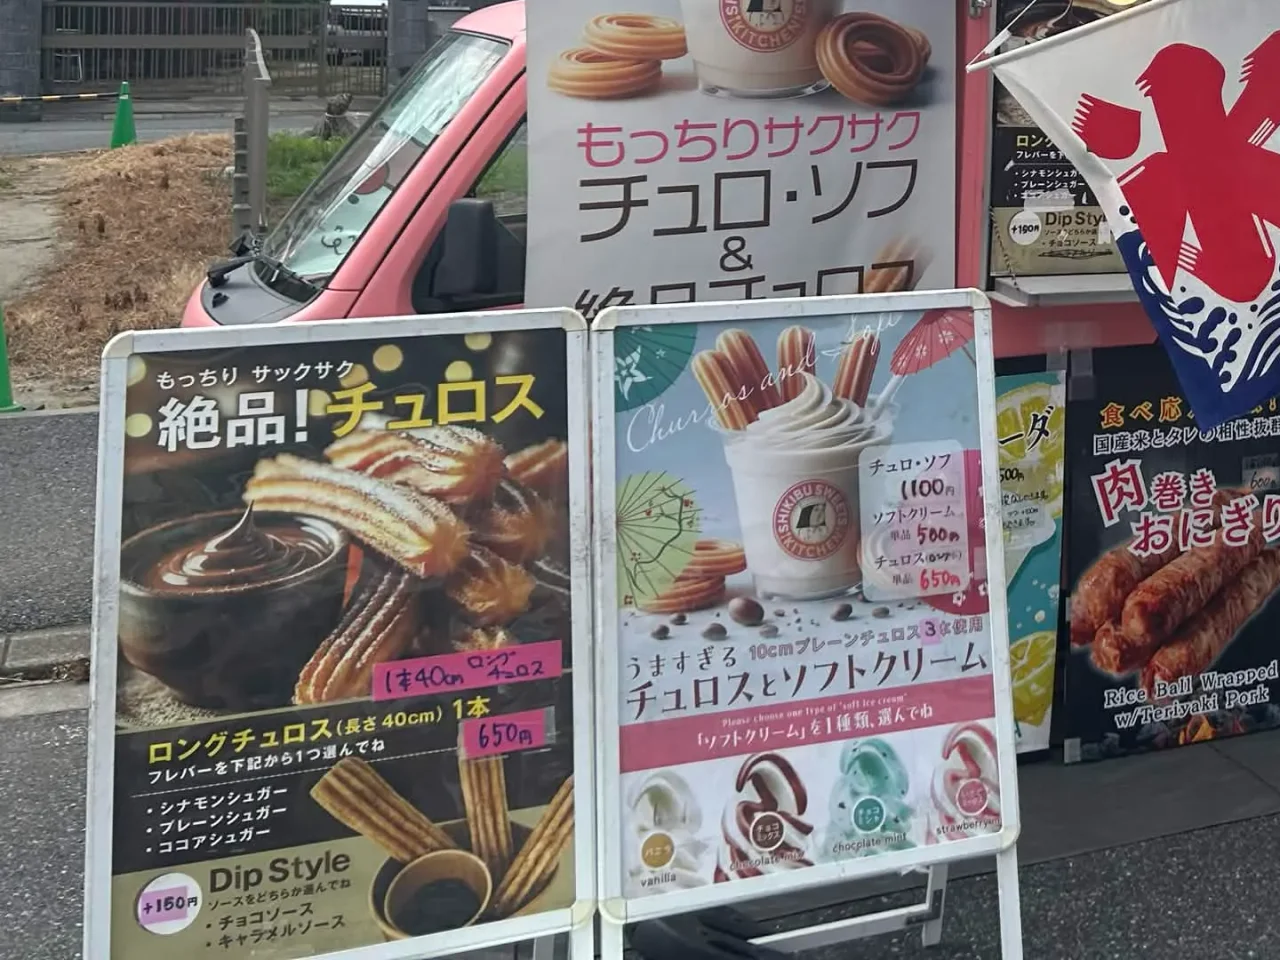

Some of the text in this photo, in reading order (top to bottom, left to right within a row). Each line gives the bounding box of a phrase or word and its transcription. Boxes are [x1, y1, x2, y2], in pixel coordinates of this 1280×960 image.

[577, 112, 921, 167] もっちりサクサク
[1022, 169, 1081, 178] シナモンシュガ
[578, 159, 920, 243] チュロ・ソフ
[1045, 211, 1107, 227] Dip Sty
[719, 236, 753, 272] &
[156, 358, 356, 390] もっちり サックサク
[626, 381, 755, 454] Churros
[760, 331, 821, 391] and
[900, 477, 956, 501] 1100円
[1090, 458, 1218, 527] 肉巻き
[873, 504, 956, 526] ソフトクリーム
[466, 650, 517, 671] ロング
[625, 644, 738, 680] うますぎる
[626, 640, 989, 721] チュロスとソフトクリーム
[1104, 659, 1279, 709] Rice Ball Wrapped
[453, 696, 491, 720] 1本
[1114, 684, 1270, 730] w/Teriyaki Pork
[477, 722, 534, 748] 650円
[148, 738, 386, 785] フレバーを下記から1つ選んでね
[159, 784, 290, 815] シナモンシュガー
[158, 827, 272, 855] ココアシュガー
[209, 849, 353, 895] Dip Style
[640, 873, 677, 888] vanilla
[217, 913, 347, 950] キャラメルソース
[218, 901, 315, 932] チョコソース
